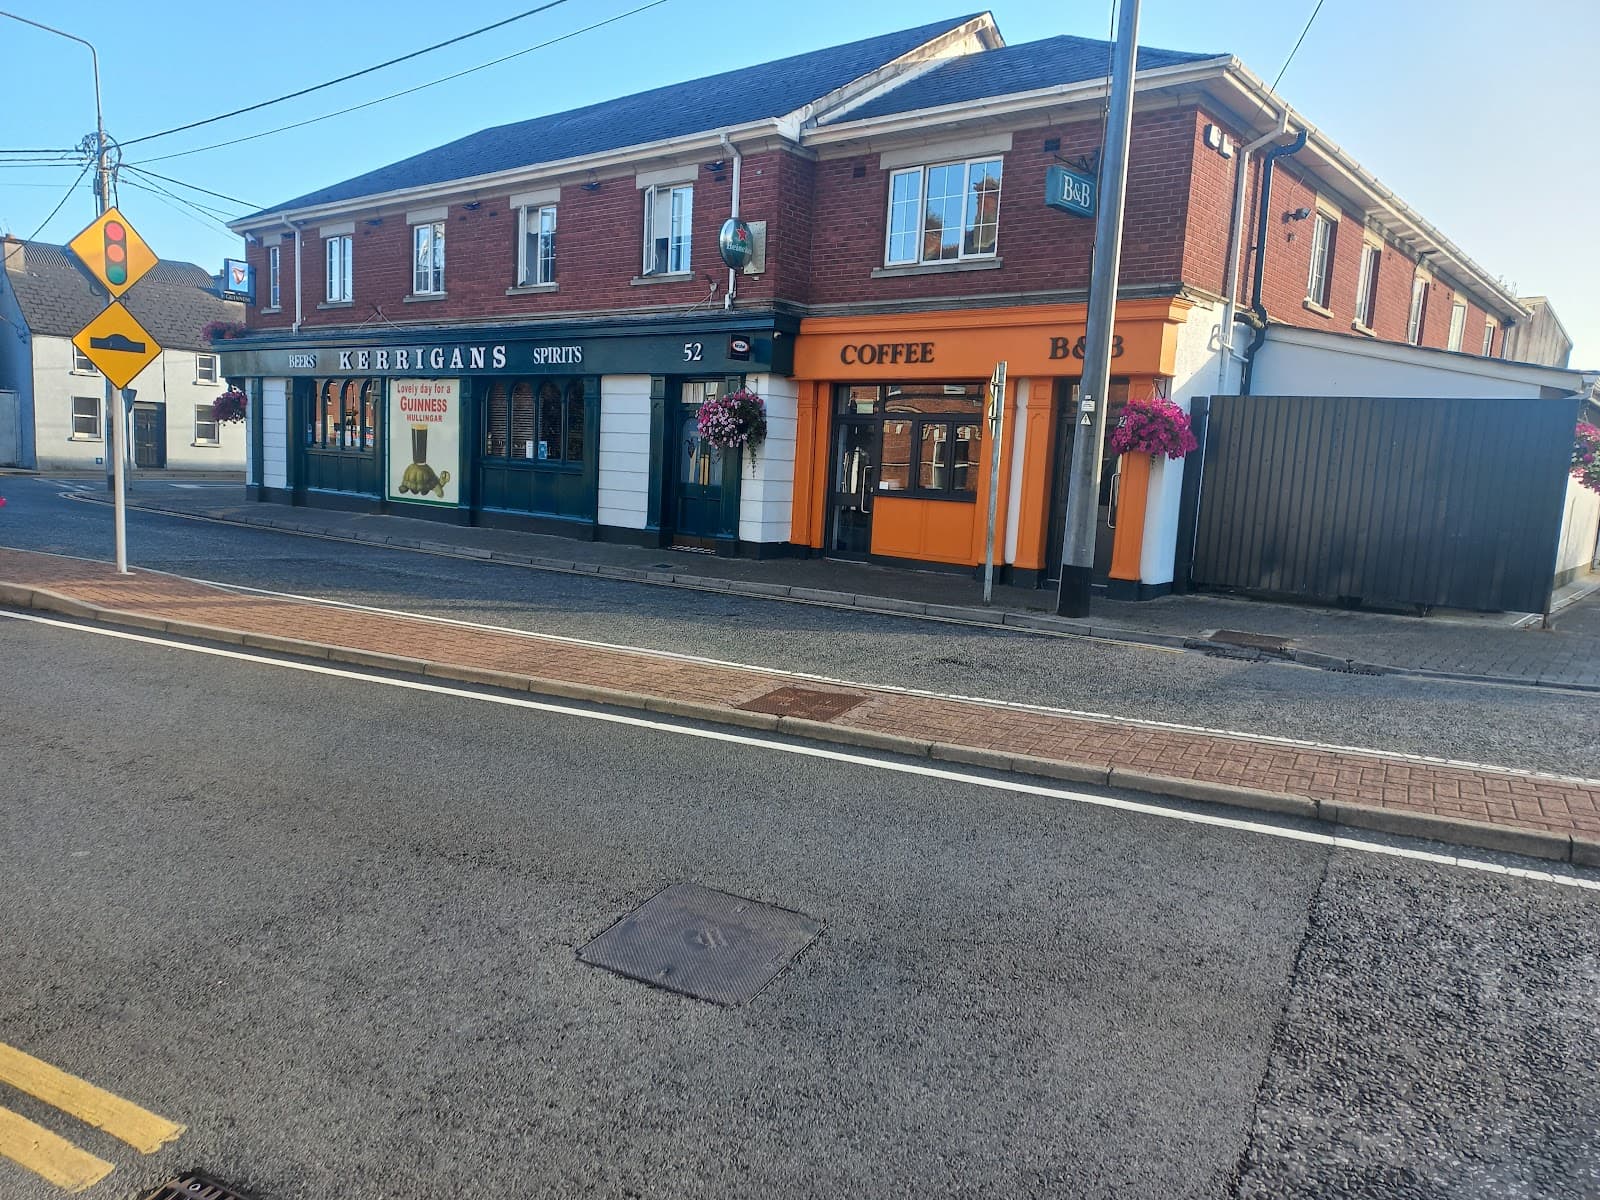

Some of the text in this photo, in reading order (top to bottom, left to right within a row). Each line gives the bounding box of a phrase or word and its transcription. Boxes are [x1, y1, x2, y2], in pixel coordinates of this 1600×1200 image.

[1063, 174, 1090, 208] B&B
[288, 342, 703, 370] BEERS KERRIGANS SPIRITS 52
[840, 342, 935, 365] COFFEE
[397, 383, 451, 396] Lovely day for a
[400, 396, 448, 413] GUINNESS
